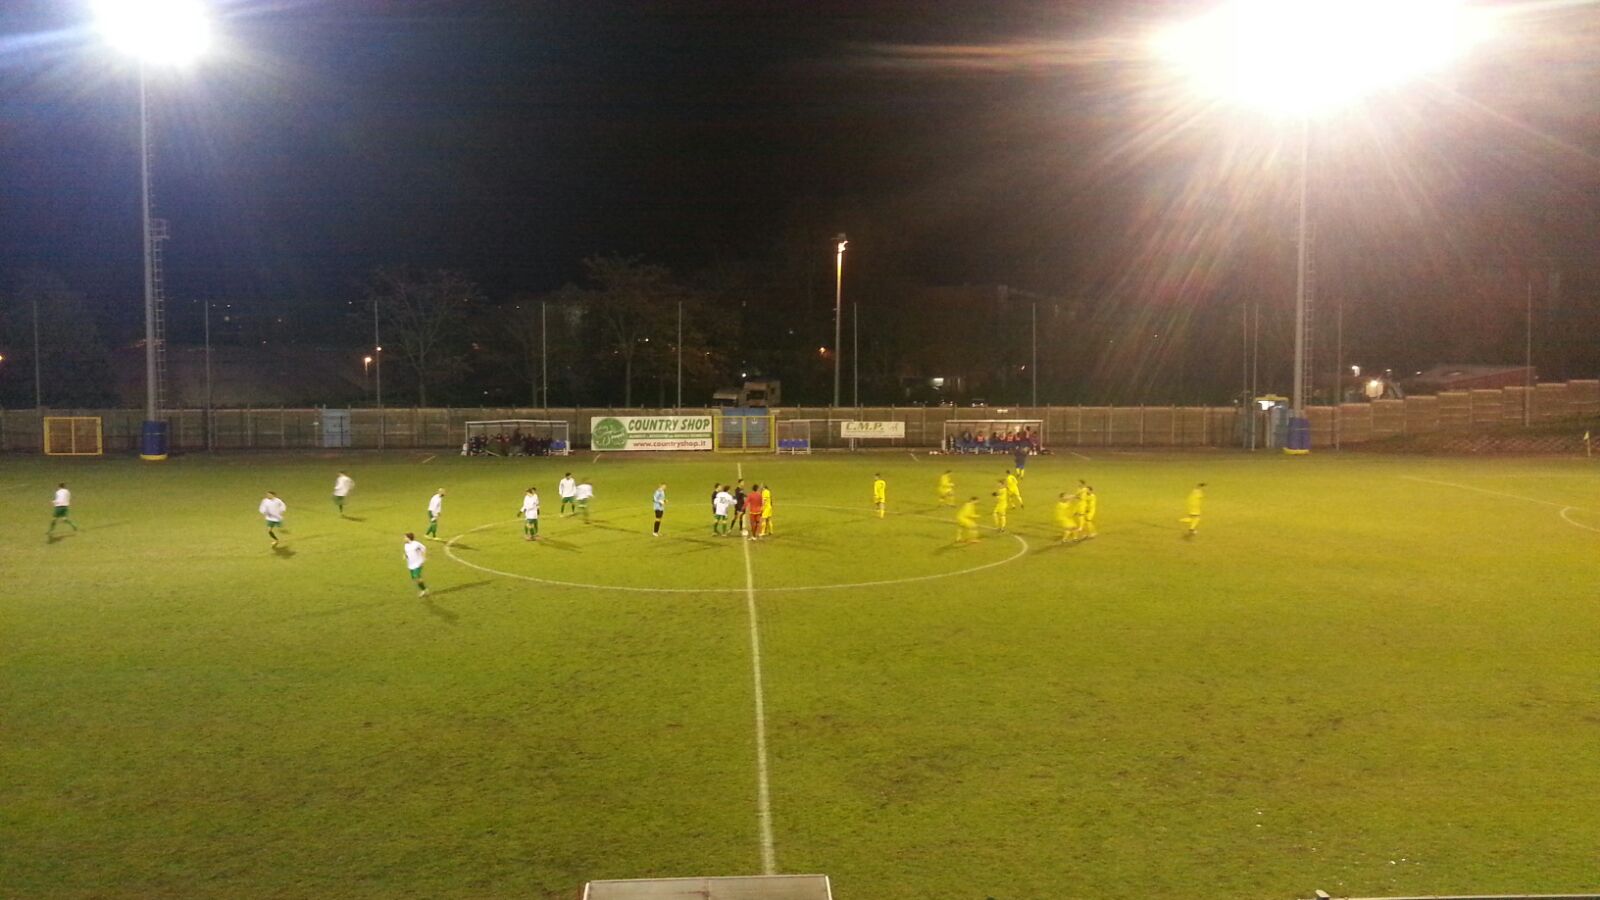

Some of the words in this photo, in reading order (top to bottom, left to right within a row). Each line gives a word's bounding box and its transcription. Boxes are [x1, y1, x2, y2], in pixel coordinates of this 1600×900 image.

[628, 419, 679, 431] COUNTRY
[680, 418, 711, 431] SHOP
[633, 440, 706, 449] www.countryshop.it
